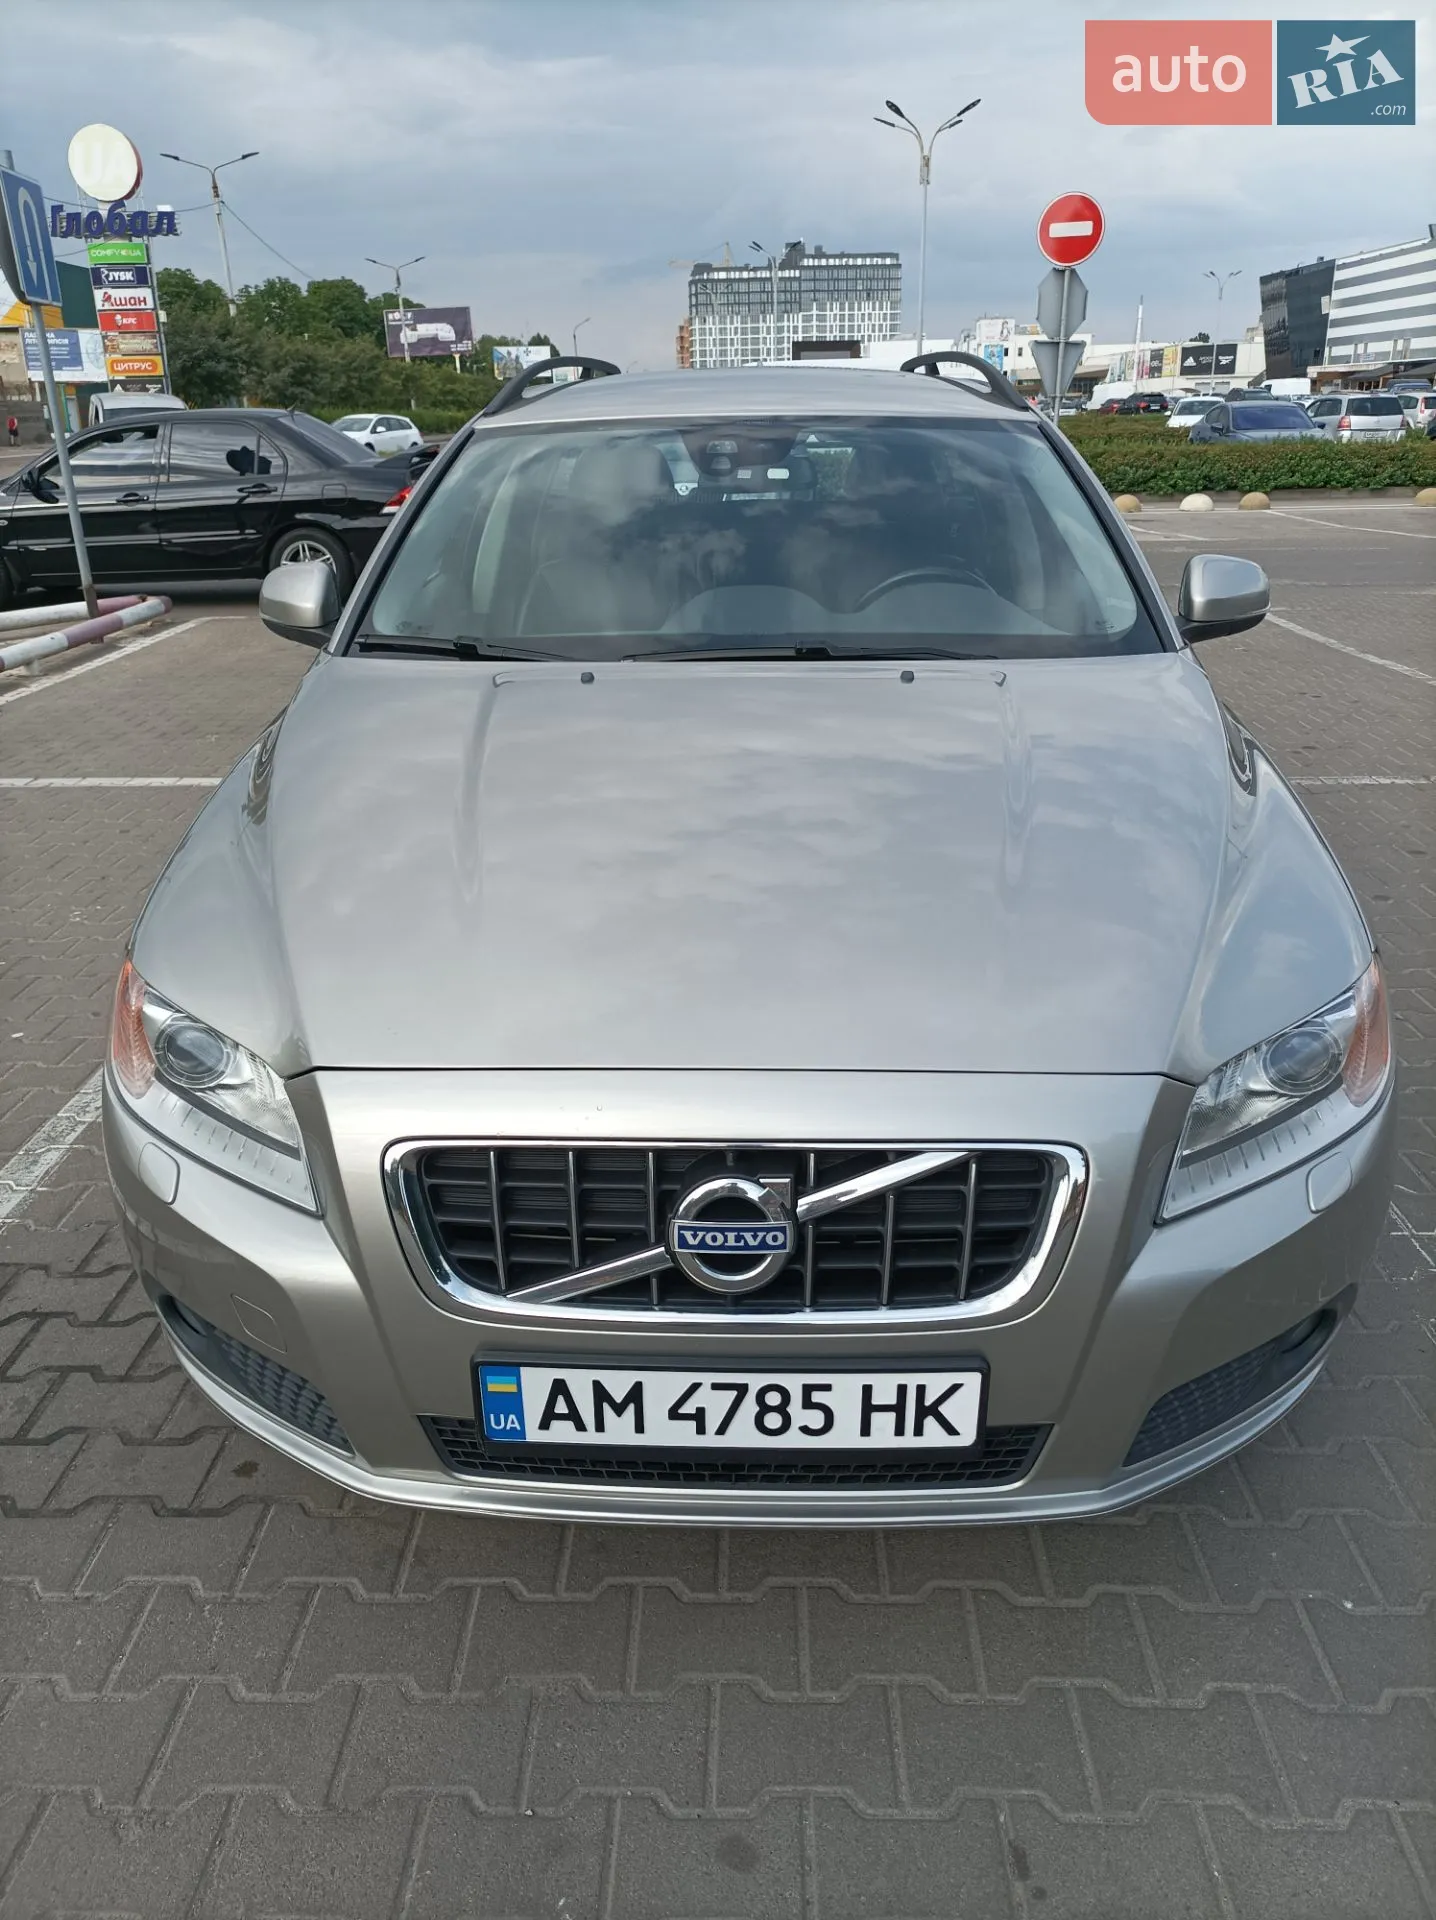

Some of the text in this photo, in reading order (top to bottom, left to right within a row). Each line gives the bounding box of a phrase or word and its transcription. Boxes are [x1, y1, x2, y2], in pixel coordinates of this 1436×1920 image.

[108, 271, 134, 281] JYSK
[101, 291, 147, 307] Ашан
[113, 361, 153, 371] ЦИТРУС
[680, 1231, 785, 1246] VOLVO
[537, 1378, 965, 1437] AM 4785 HK
[489, 1414, 521, 1432] UA
